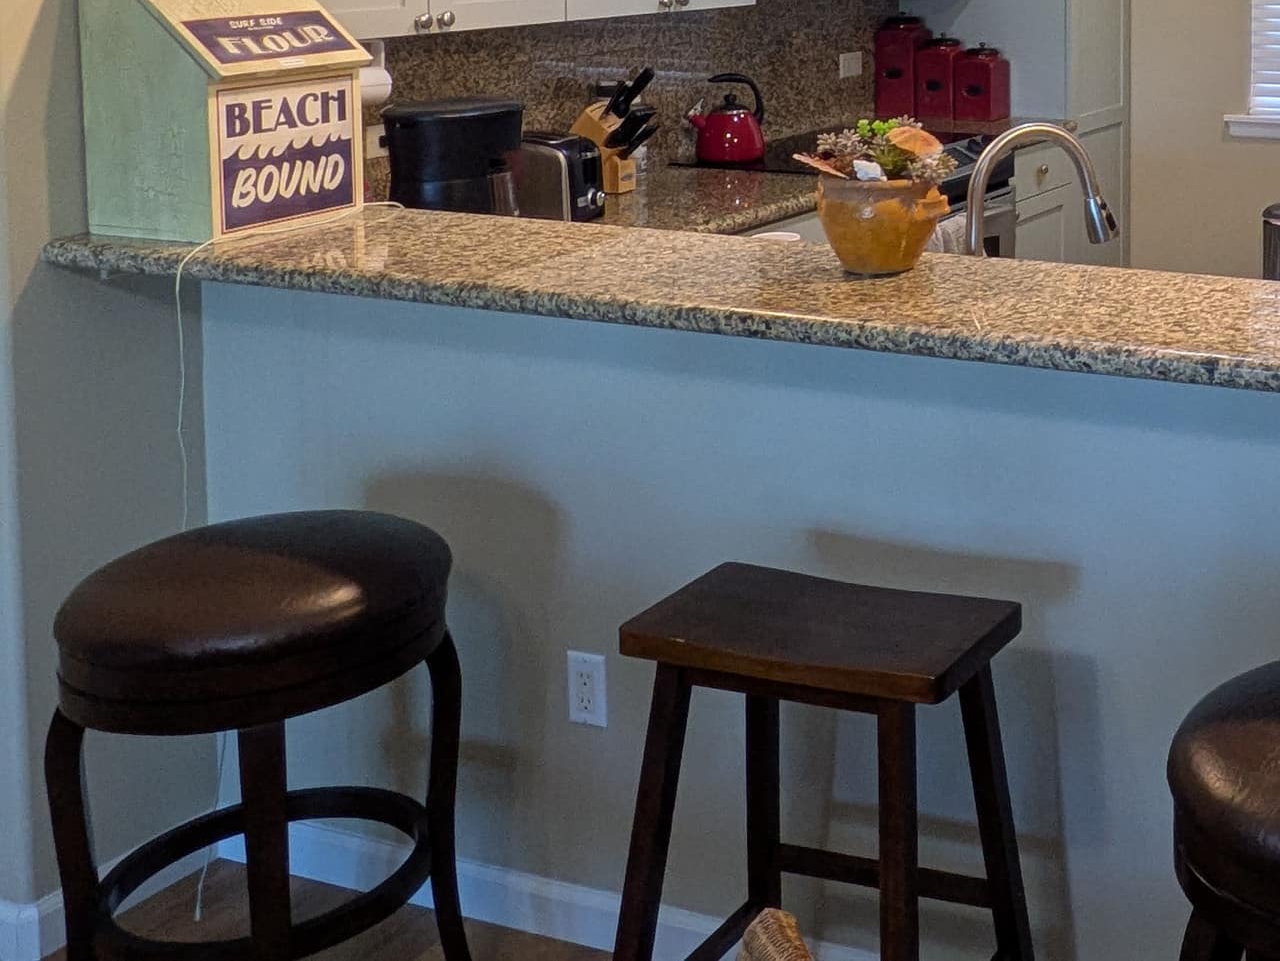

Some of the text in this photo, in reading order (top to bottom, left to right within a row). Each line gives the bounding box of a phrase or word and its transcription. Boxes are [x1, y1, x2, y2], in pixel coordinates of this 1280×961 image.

[216, 24, 335, 56] FLOUR
[229, 19, 256, 29] SURF
[259, 17, 284, 26] SIDE
[225, 89, 346, 139] BEACH
[232, 153, 345, 208] BOUND
